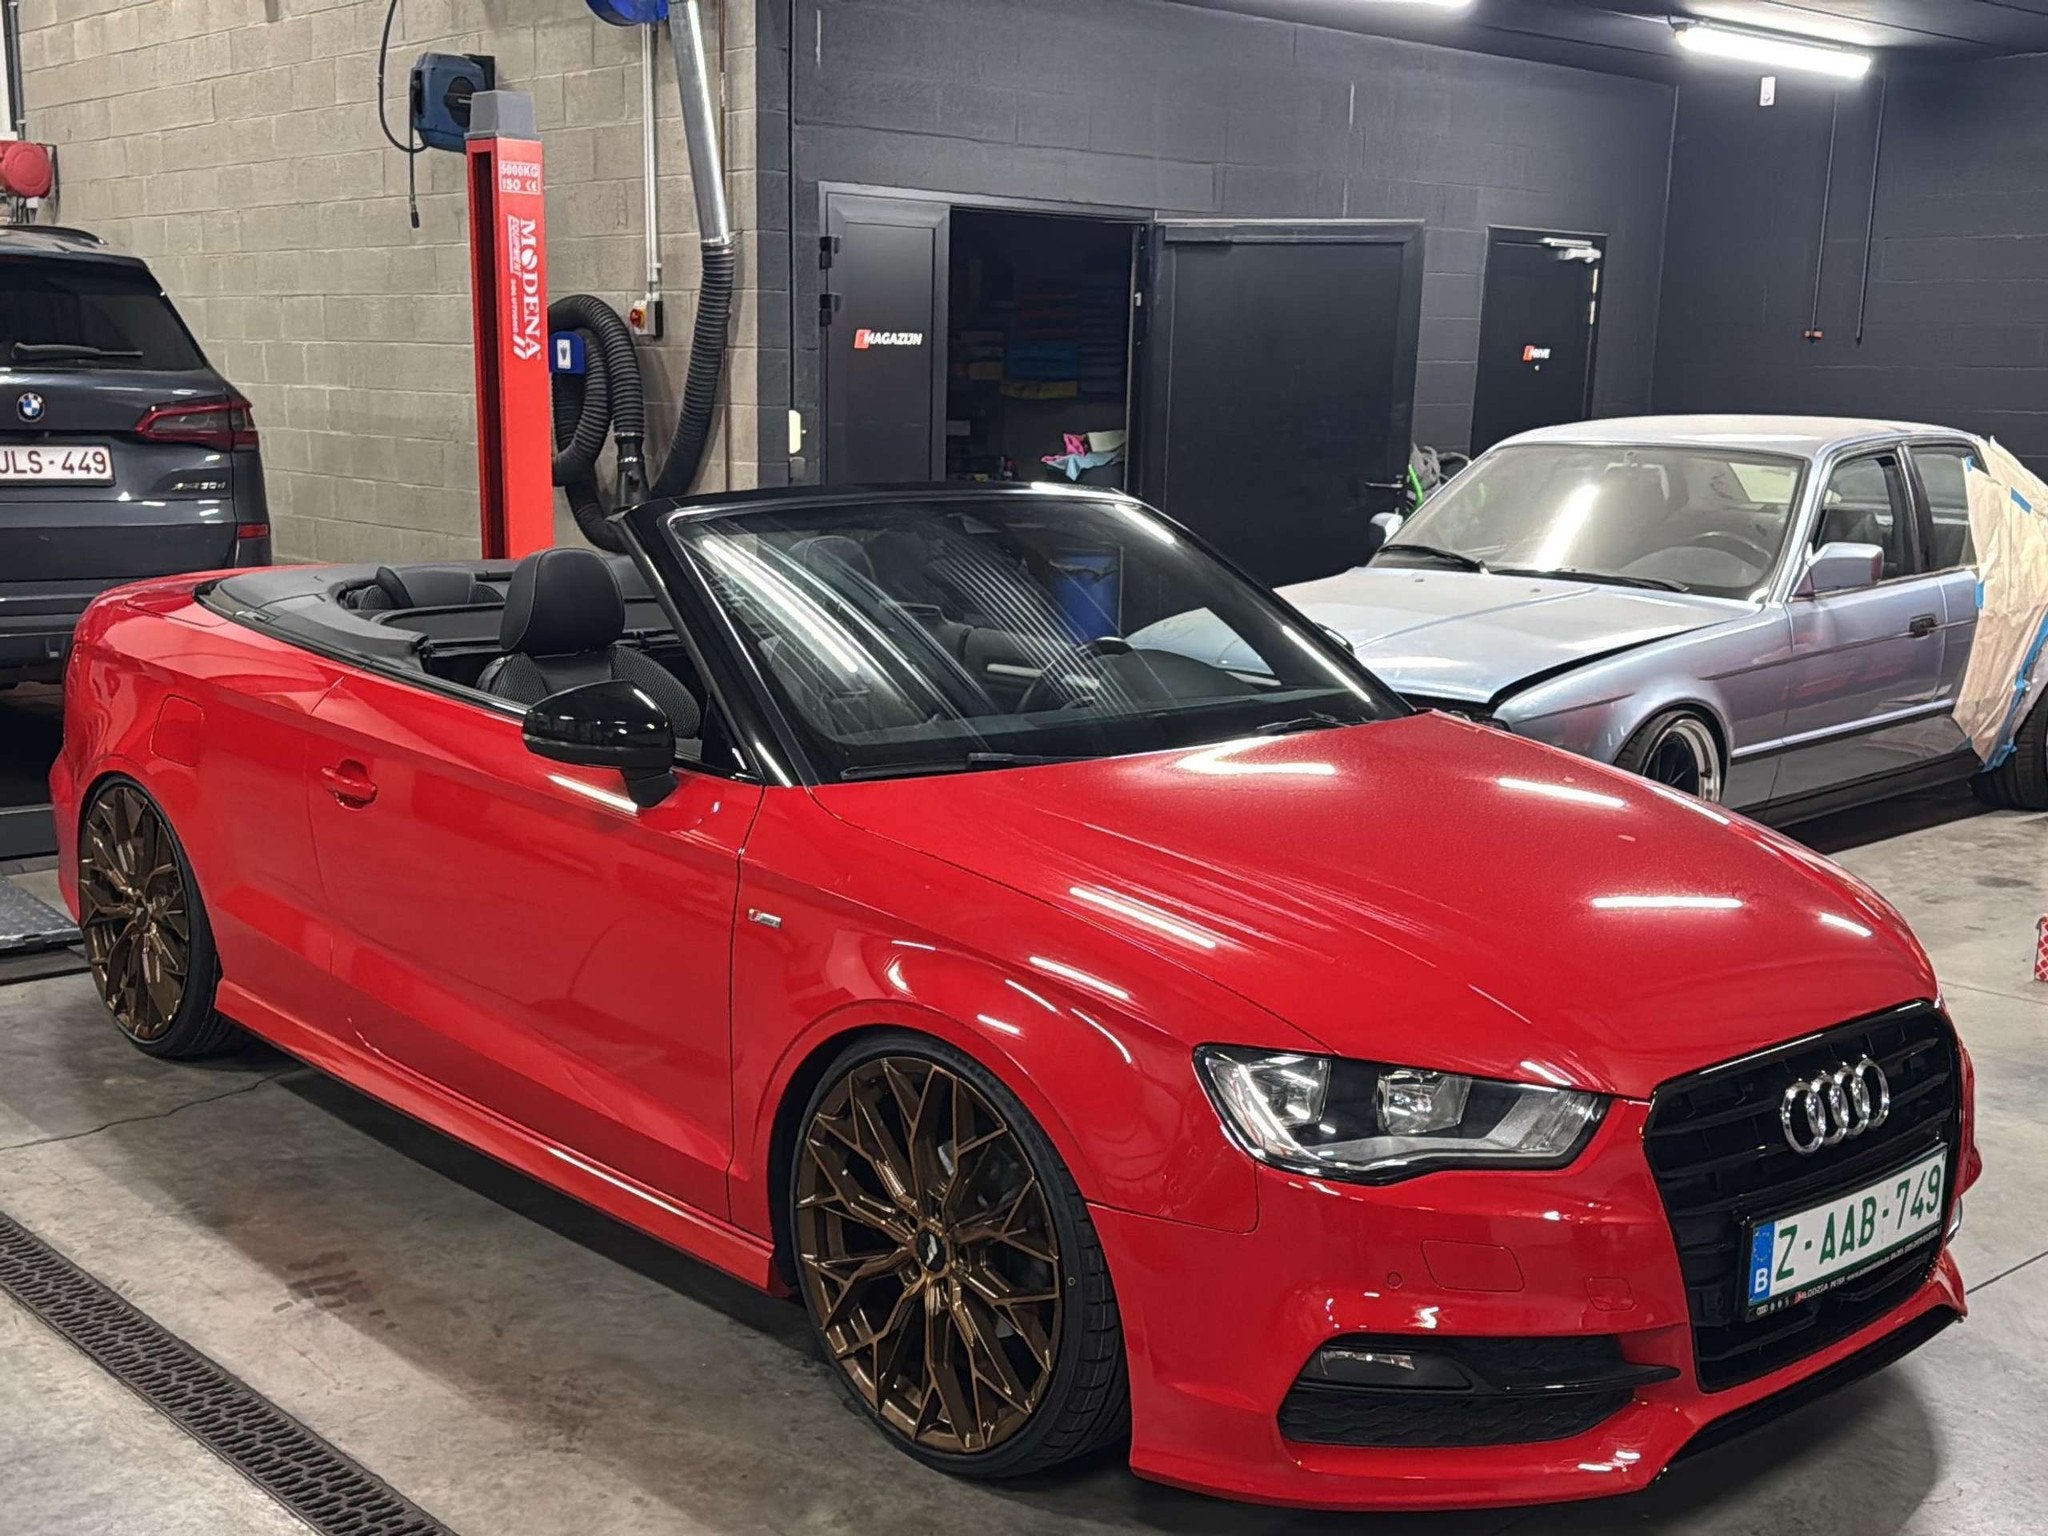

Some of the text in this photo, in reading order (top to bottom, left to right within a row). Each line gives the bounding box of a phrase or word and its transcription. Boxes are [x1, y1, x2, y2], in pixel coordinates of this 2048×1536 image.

[520, 217, 541, 359] MODENA
[863, 331, 923, 346] MAGAZIJN
[1776, 1164, 1942, 1283] Z-AAB-749
[1754, 1267, 1769, 1294] B
